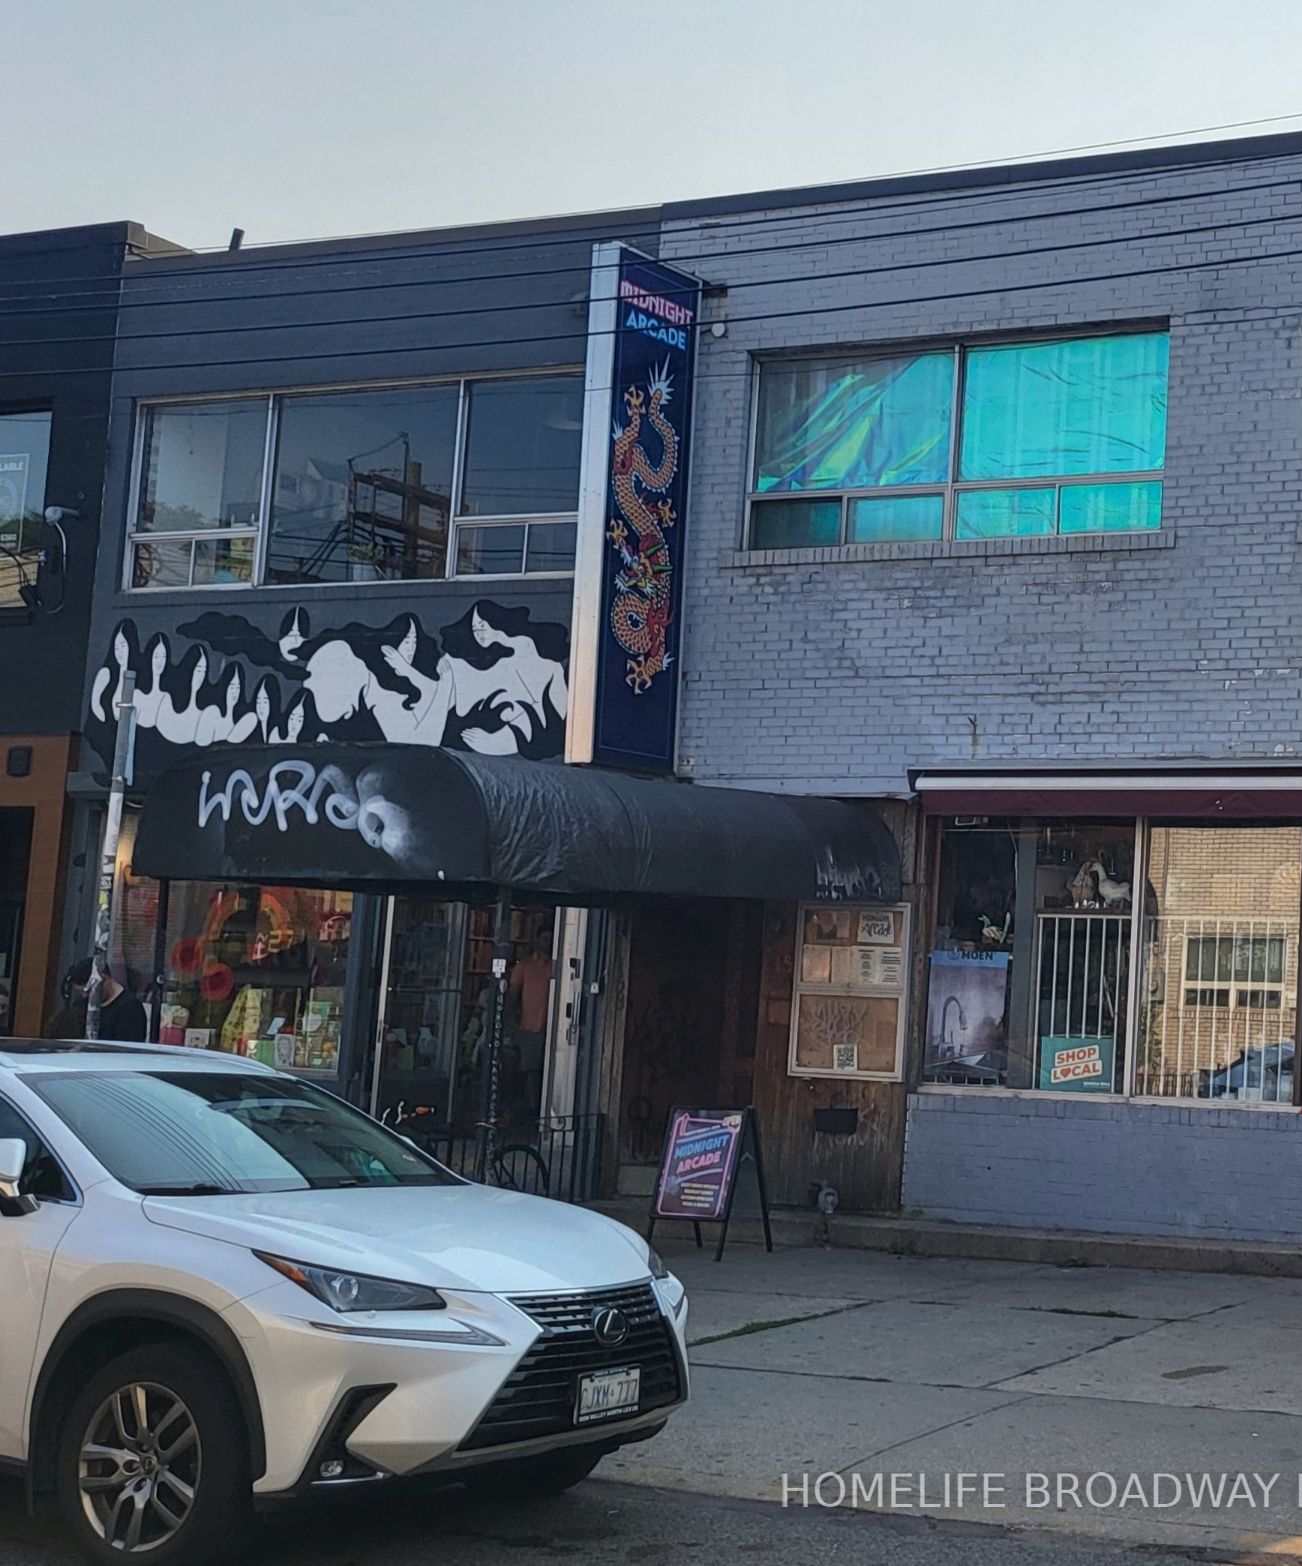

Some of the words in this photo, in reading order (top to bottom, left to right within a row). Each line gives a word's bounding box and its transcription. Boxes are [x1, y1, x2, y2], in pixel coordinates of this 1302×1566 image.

[621, 280, 693, 330] MIDNIGHT
[626, 309, 686, 350] ARCADE
[962, 950, 994, 961] MOEN
[1056, 1047, 1097, 1064] SHOP
[674, 1135, 730, 1159] MIDNIGHT
[676, 1151, 722, 1174] ARCADE
[617, 1379, 638, 1405] 777
